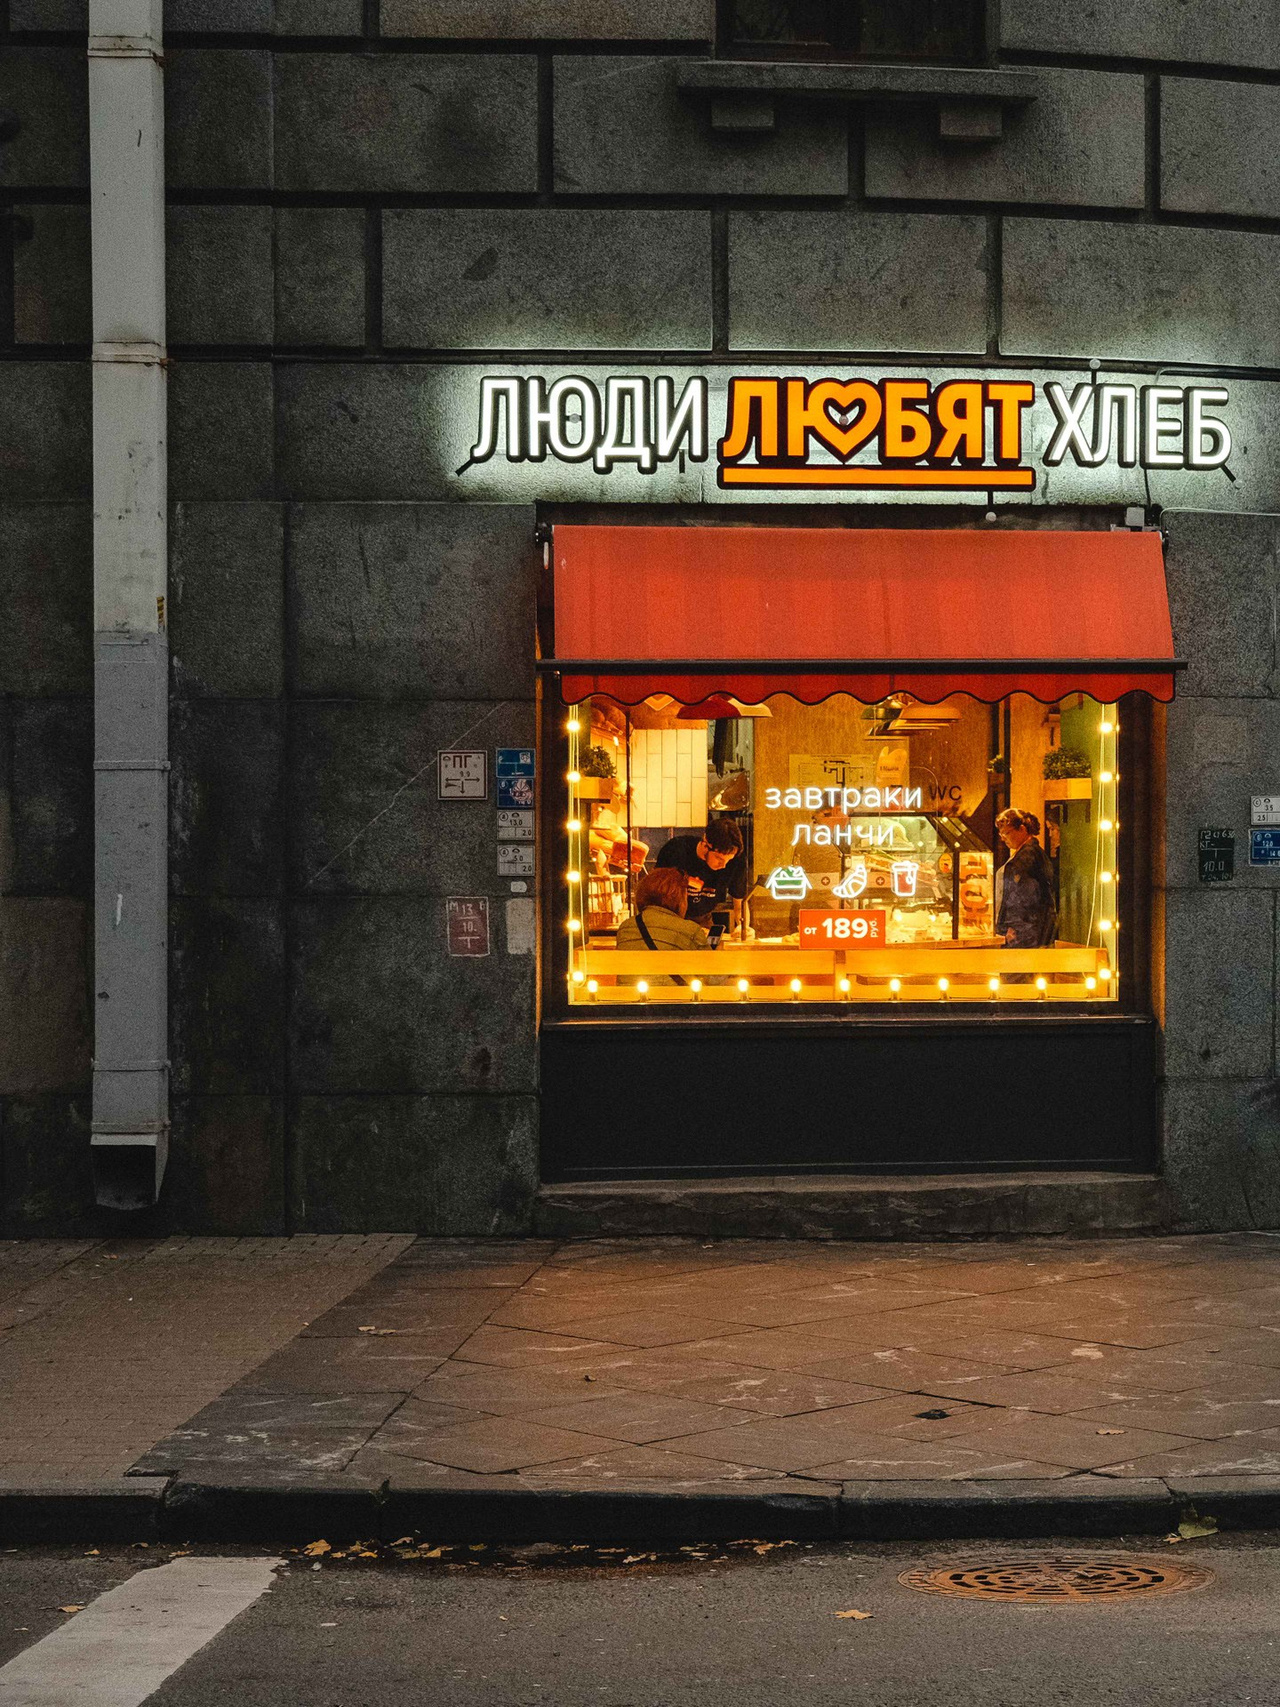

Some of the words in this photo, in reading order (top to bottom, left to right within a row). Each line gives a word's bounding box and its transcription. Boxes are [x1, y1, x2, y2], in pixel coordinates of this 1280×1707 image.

[472, 377, 704, 469] ЛЮДИ
[721, 377, 1035, 462] ЛЮБЯТ
[1043, 380, 1234, 466] ХЛЕБ
[453, 754, 473, 769] ПГ
[764, 785, 923, 816] завтраки
[928, 785, 963, 801] WC
[791, 823, 895, 847] ланчи
[803, 926, 817, 935] от
[821, 917, 869, 939] 189
[869, 917, 879, 938] руб.
